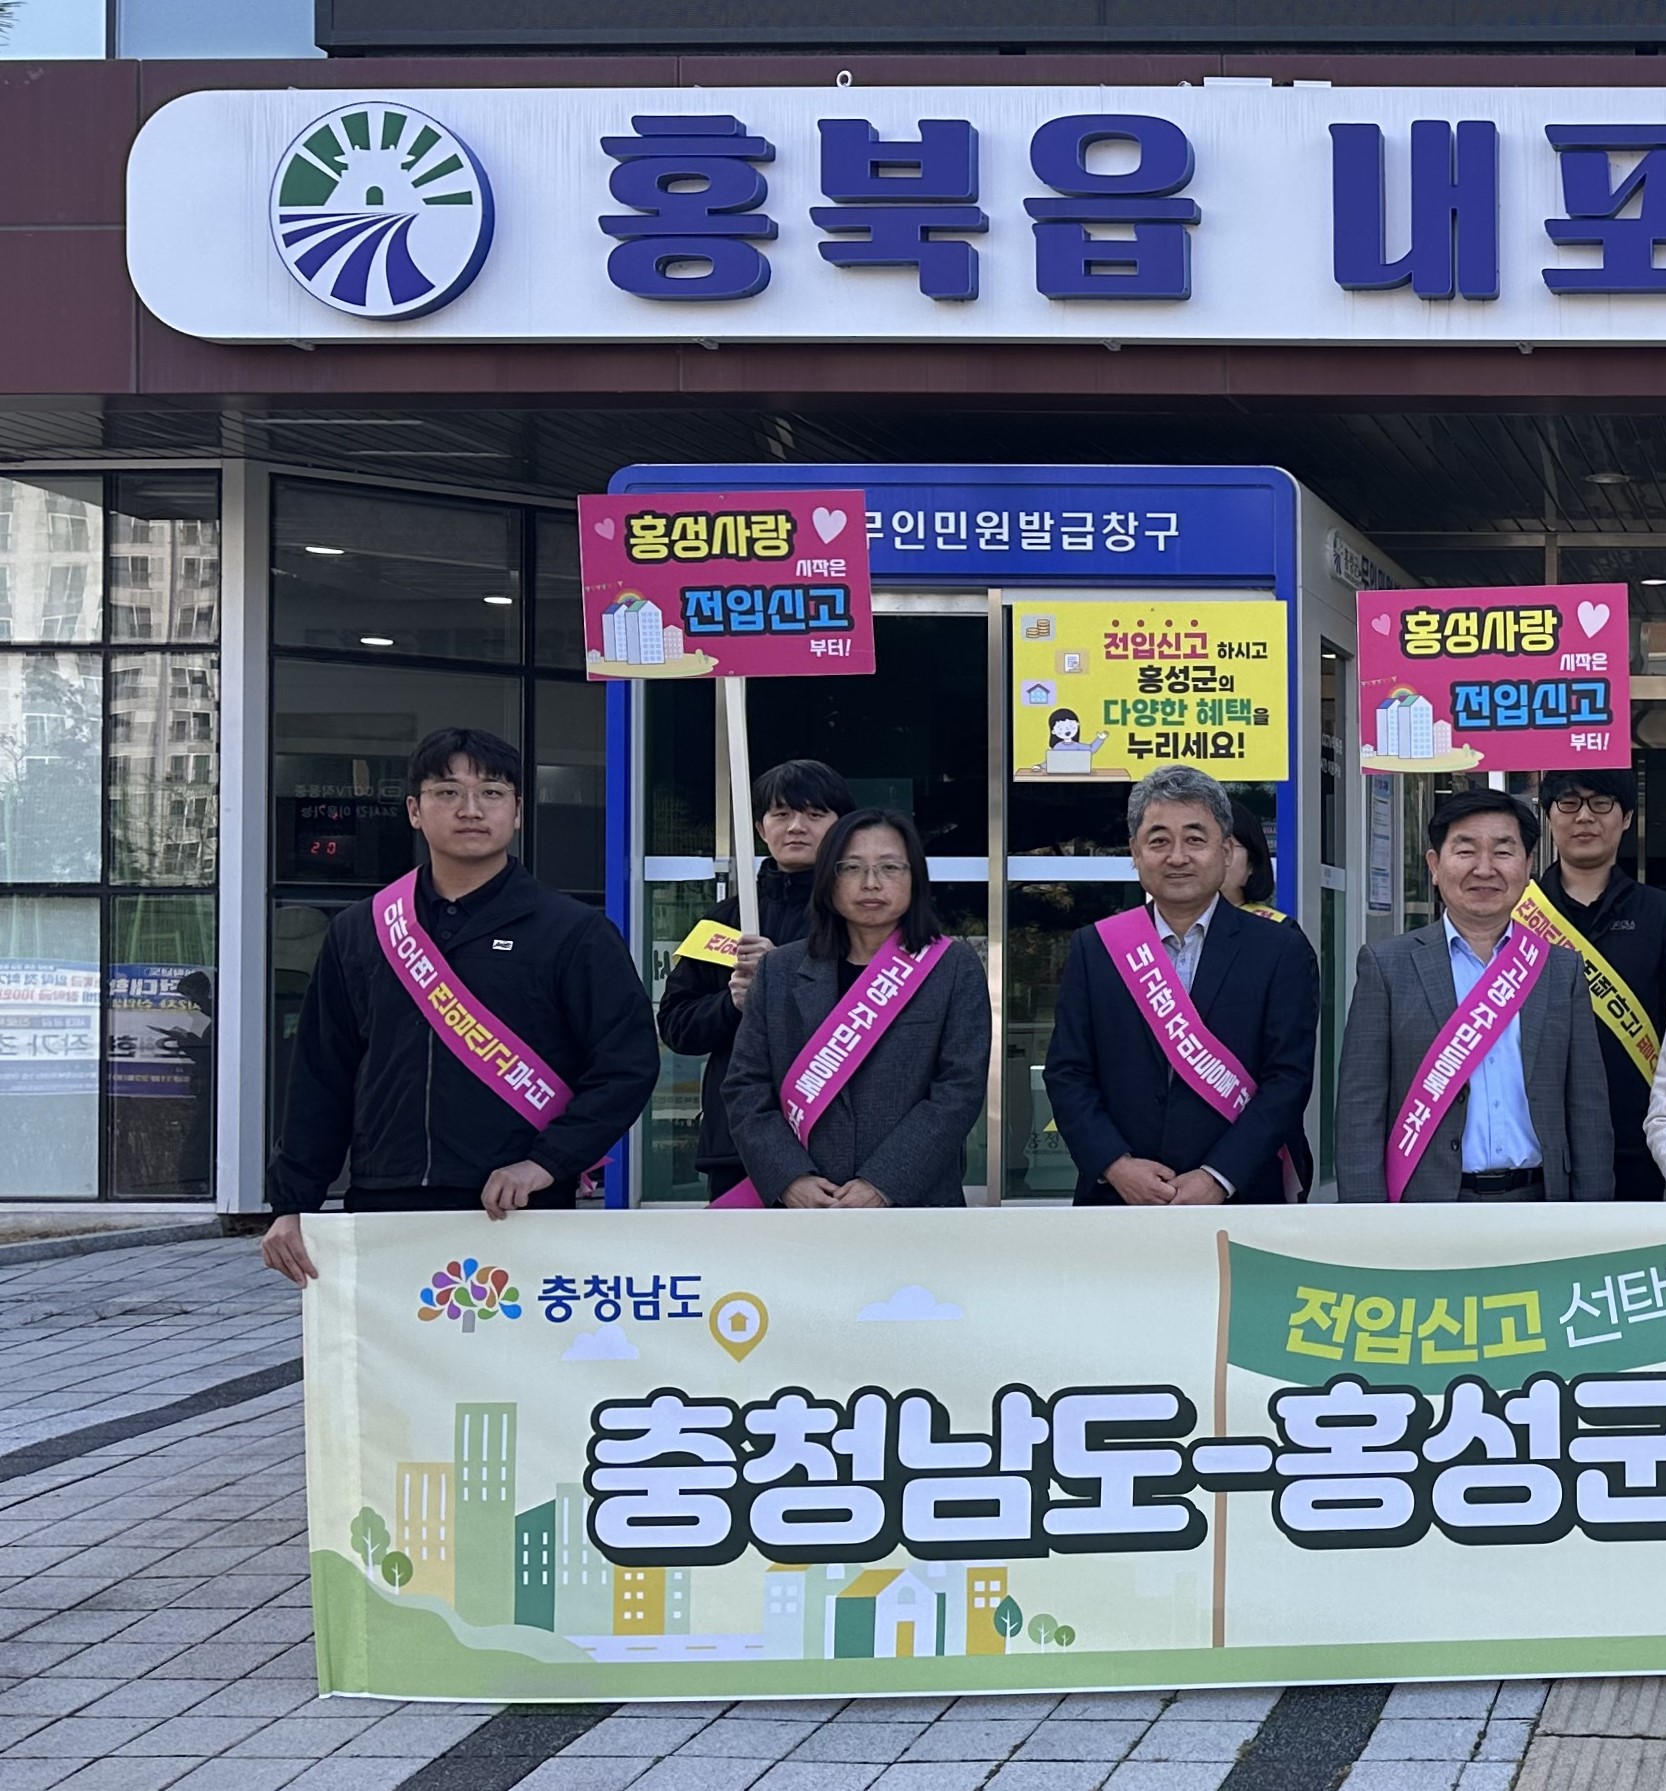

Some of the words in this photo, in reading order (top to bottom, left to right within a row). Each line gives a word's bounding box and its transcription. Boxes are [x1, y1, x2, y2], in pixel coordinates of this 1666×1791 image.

[599, 113, 1201, 302] 홍북읍
[627, 513, 794, 561] 홍성사랑
[863, 510, 1180, 552] 무인민원발급창구
[796, 559, 846, 577] 시작은
[683, 587, 851, 634] 전입신고
[1401, 606, 1560, 658] 홍성사랑
[810, 639, 852, 657] 부터!
[1103, 632, 1209, 660] 전입신고
[1217, 642, 1268, 660] 하시고
[1560, 653, 1608, 672] 시작은
[1137, 666, 1234, 693] 홍성군의
[1103, 699, 1186, 726] 다양한
[1195, 699, 1269, 726] 혜택을
[1453, 680, 1609, 728] 전입신고
[1127, 731, 1245, 760] 누리세요!
[1570, 732, 1611, 752] 부터!
[1126, 942, 1155, 973] 내
[1518, 935, 1539, 967] 내
[383, 897, 438, 989] 이사오면
[428, 982, 556, 1111] 전입신고부터
[866, 955, 915, 1007] 고장
[1139, 967, 1175, 1018] 고장
[1487, 955, 1529, 1008] 고장
[794, 1001, 878, 1104] 주민등록
[1165, 1012, 1240, 1099] 주민등록
[1423, 1002, 1498, 1102] 주민등록
[1398, 1098, 1432, 1157] 갖기
[538, 1275, 703, 1323] 충청남도
[1285, 1285, 1547, 1366] 전입신고
